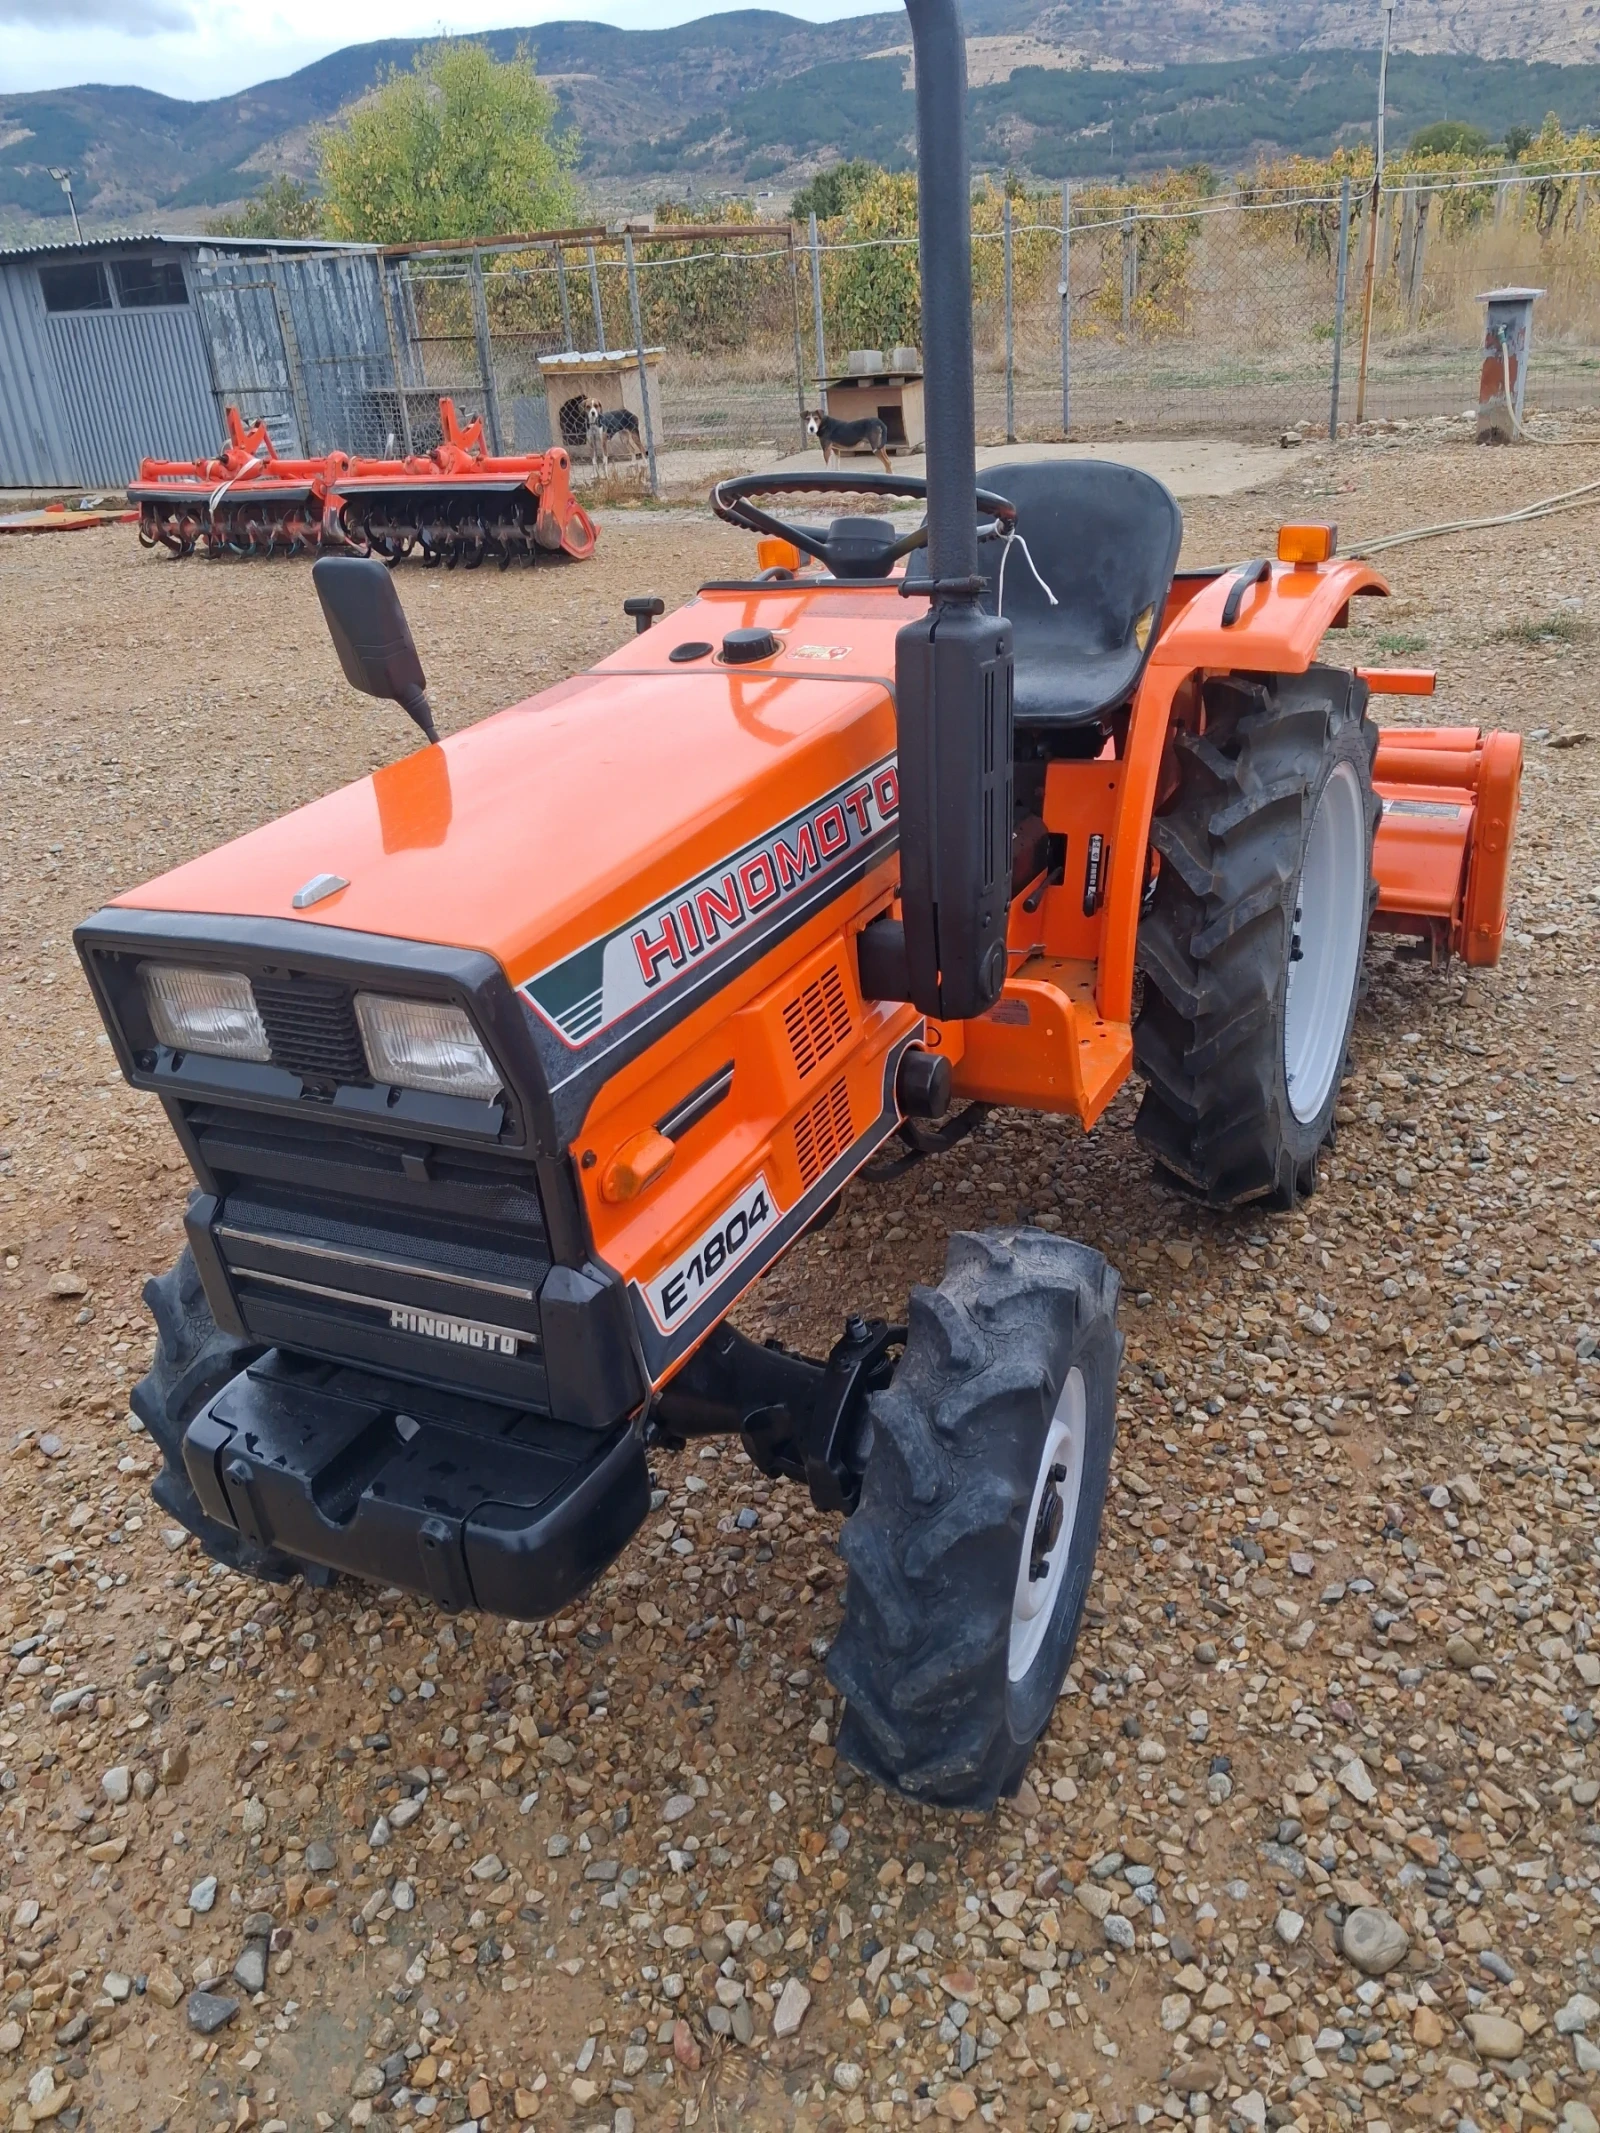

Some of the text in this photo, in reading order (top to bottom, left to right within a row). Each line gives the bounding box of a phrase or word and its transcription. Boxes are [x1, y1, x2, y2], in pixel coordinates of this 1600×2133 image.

[631, 765, 899, 988] HINOMOTO
[661, 1190, 769, 1320] E1804
[390, 1309, 517, 1356] HINOMOTO
